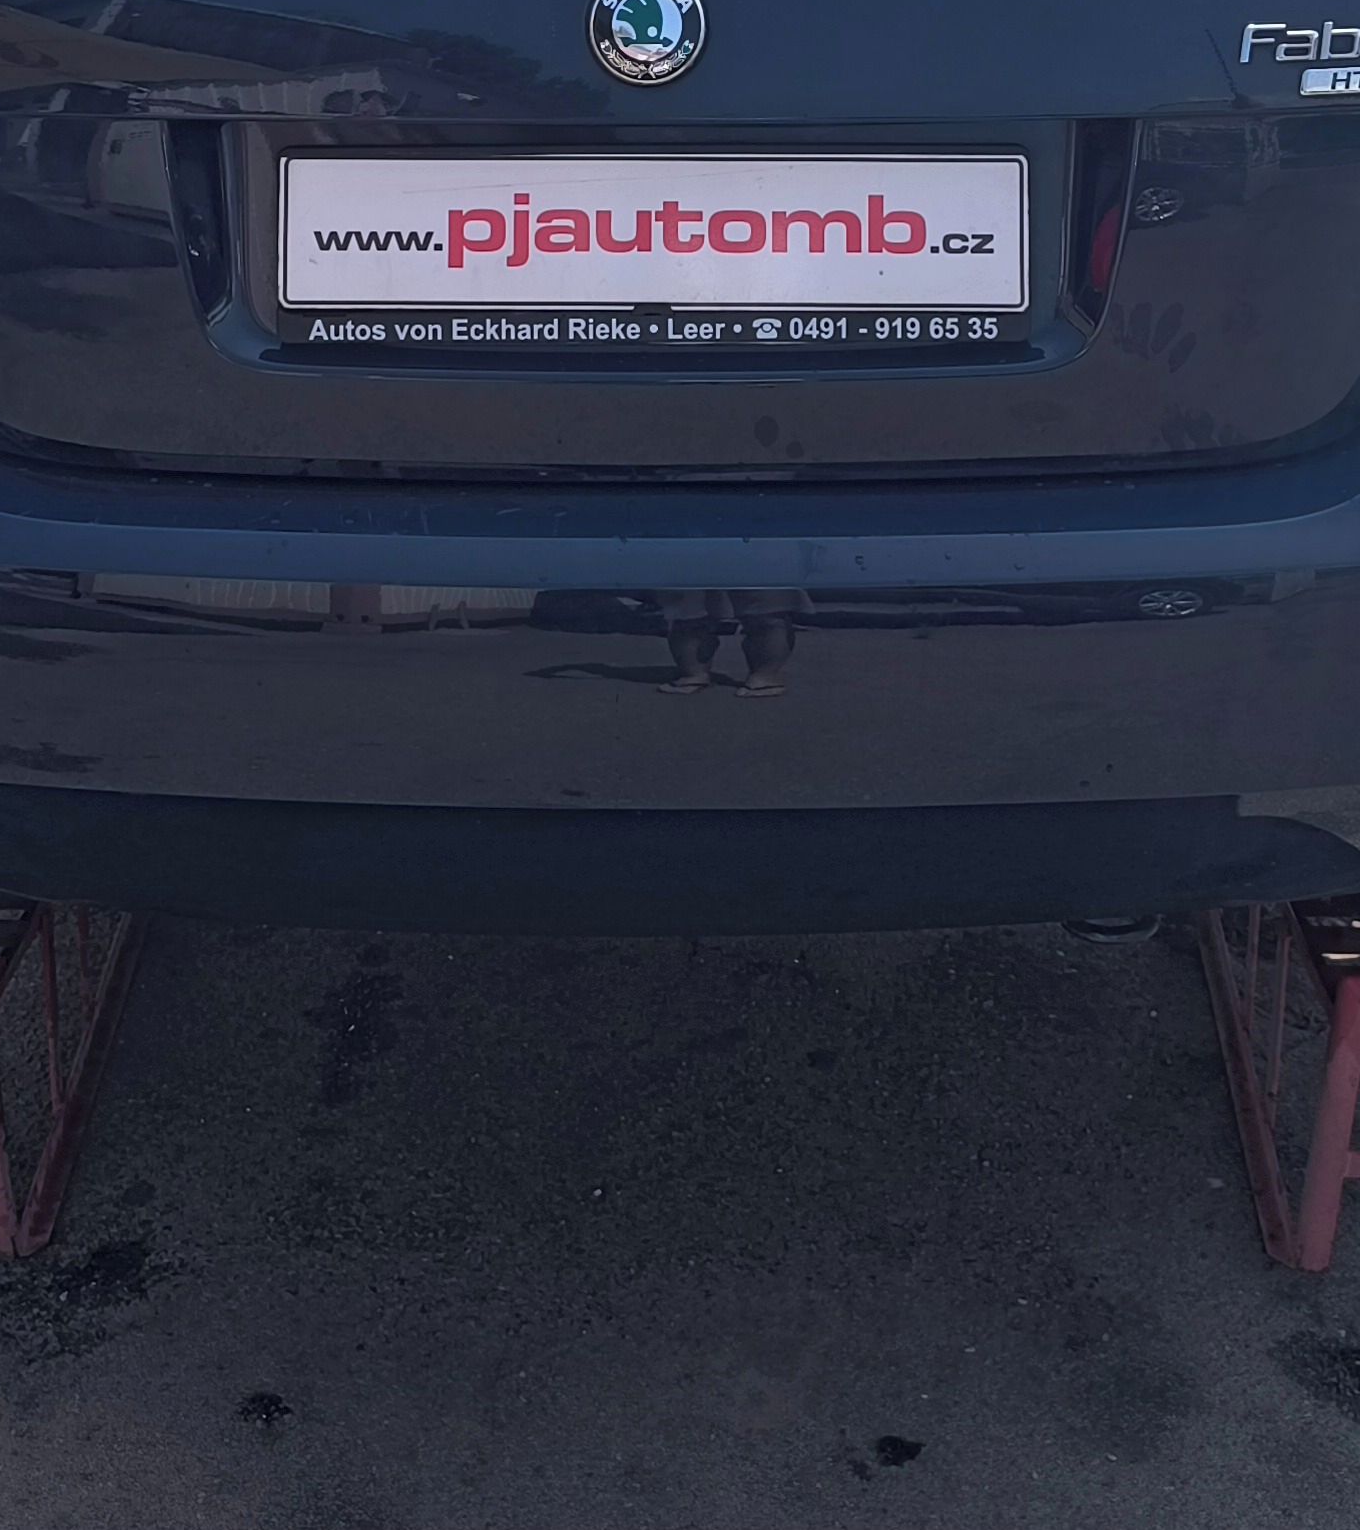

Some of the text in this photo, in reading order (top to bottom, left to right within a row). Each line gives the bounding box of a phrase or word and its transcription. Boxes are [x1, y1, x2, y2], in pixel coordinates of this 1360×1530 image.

[313, 193, 995, 269] www.pjautomb.cz
[309, 319, 386, 341] Autos
[395, 325, 442, 341] von
[451, 318, 559, 341] Eckhard
[568, 318, 641, 340] Rieke
[667, 318, 725, 340] Leer
[789, 317, 847, 339] 0491
[874, 317, 921, 339] 919
[929, 317, 959, 339] 65
[967, 317, 998, 339] 35
